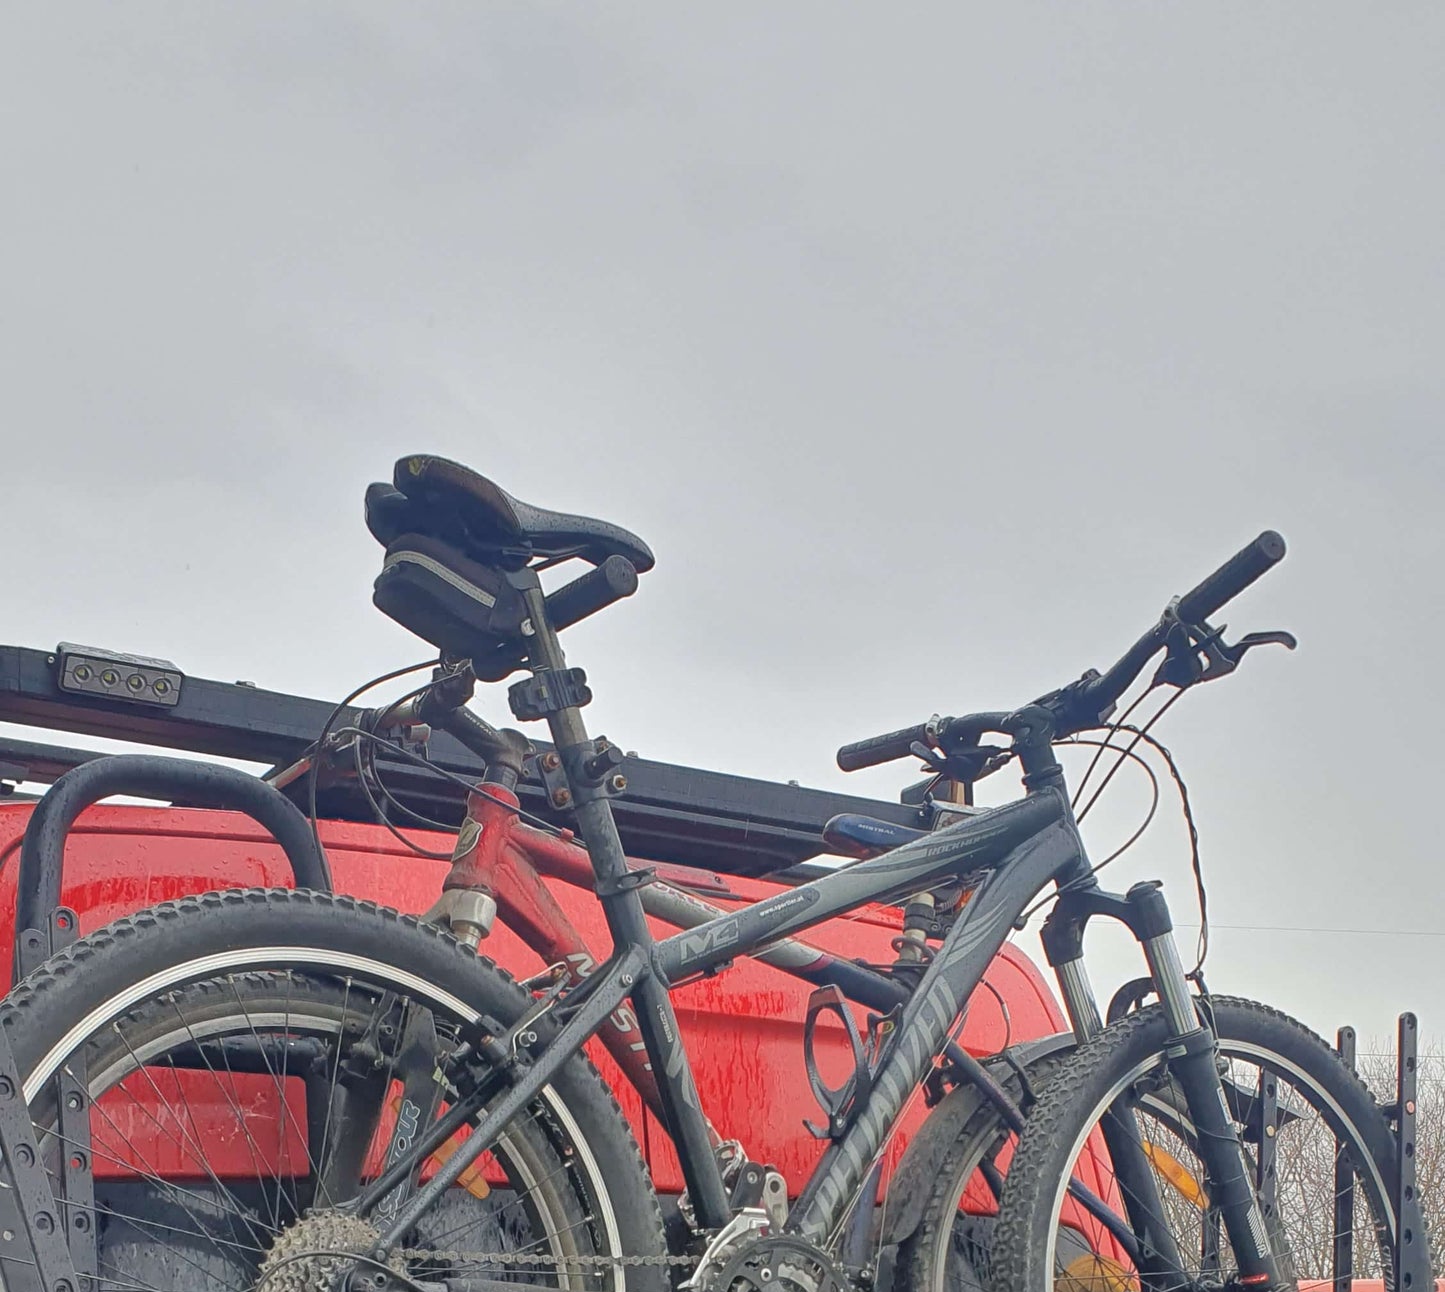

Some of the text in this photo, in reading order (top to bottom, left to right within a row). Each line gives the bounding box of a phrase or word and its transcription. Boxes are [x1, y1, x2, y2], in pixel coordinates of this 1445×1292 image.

[857, 823, 896, 836] MISTRAL
[679, 918, 740, 962] M4
[800, 975, 958, 1240] SPECIALIZED
